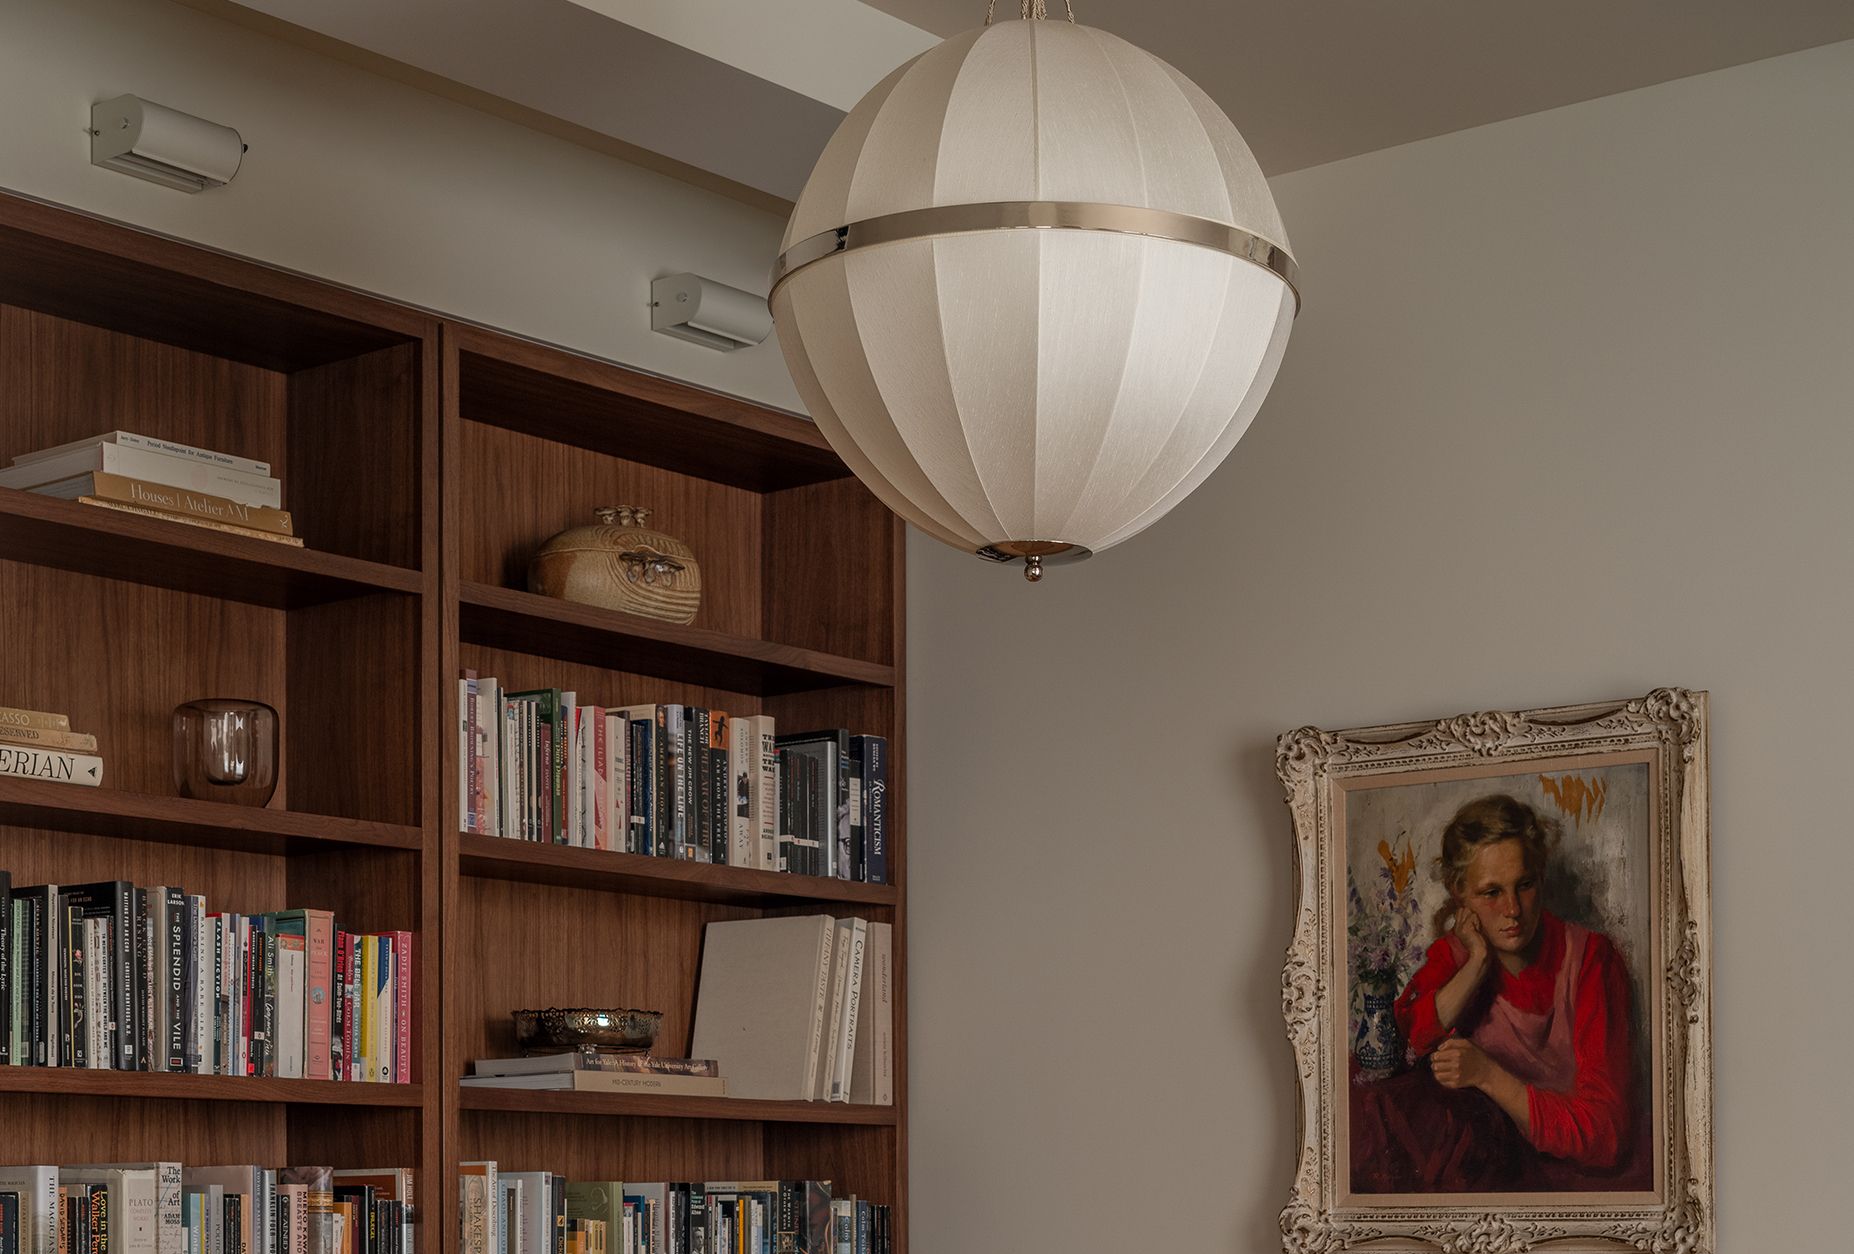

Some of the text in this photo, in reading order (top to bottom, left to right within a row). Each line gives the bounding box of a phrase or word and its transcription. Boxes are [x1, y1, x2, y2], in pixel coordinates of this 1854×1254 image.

[129, 482, 174, 506] Houses
[184, 495, 224, 516] Atelier
[0, 711, 30, 726] ASSO
[676, 733, 684, 753] LIFE
[676, 757, 684, 771] ON
[676, 774, 684, 788] THE
[701, 747, 710, 848] PILLAR OF FIRE
[872, 779, 886, 855] ROMANTICISM
[0, 953, 7, 961] of
[172, 925, 181, 991] SPLENDID
[354, 948, 362, 965] THE
[353, 991, 361, 1008] JAR
[847, 940, 863, 1049] CAMERA PORTRAITS
[401, 1019, 407, 1032] ON
[173, 1023, 181, 1050] VILE
[161, 1175, 180, 1183] Work
[172, 1191, 180, 1199] of
[491, 1191, 497, 1199] of
[92, 1191, 100, 1230] Walker
[100, 1191, 108, 1217] Love
[100, 1220, 108, 1231] in
[100, 1234, 108, 1251] the
